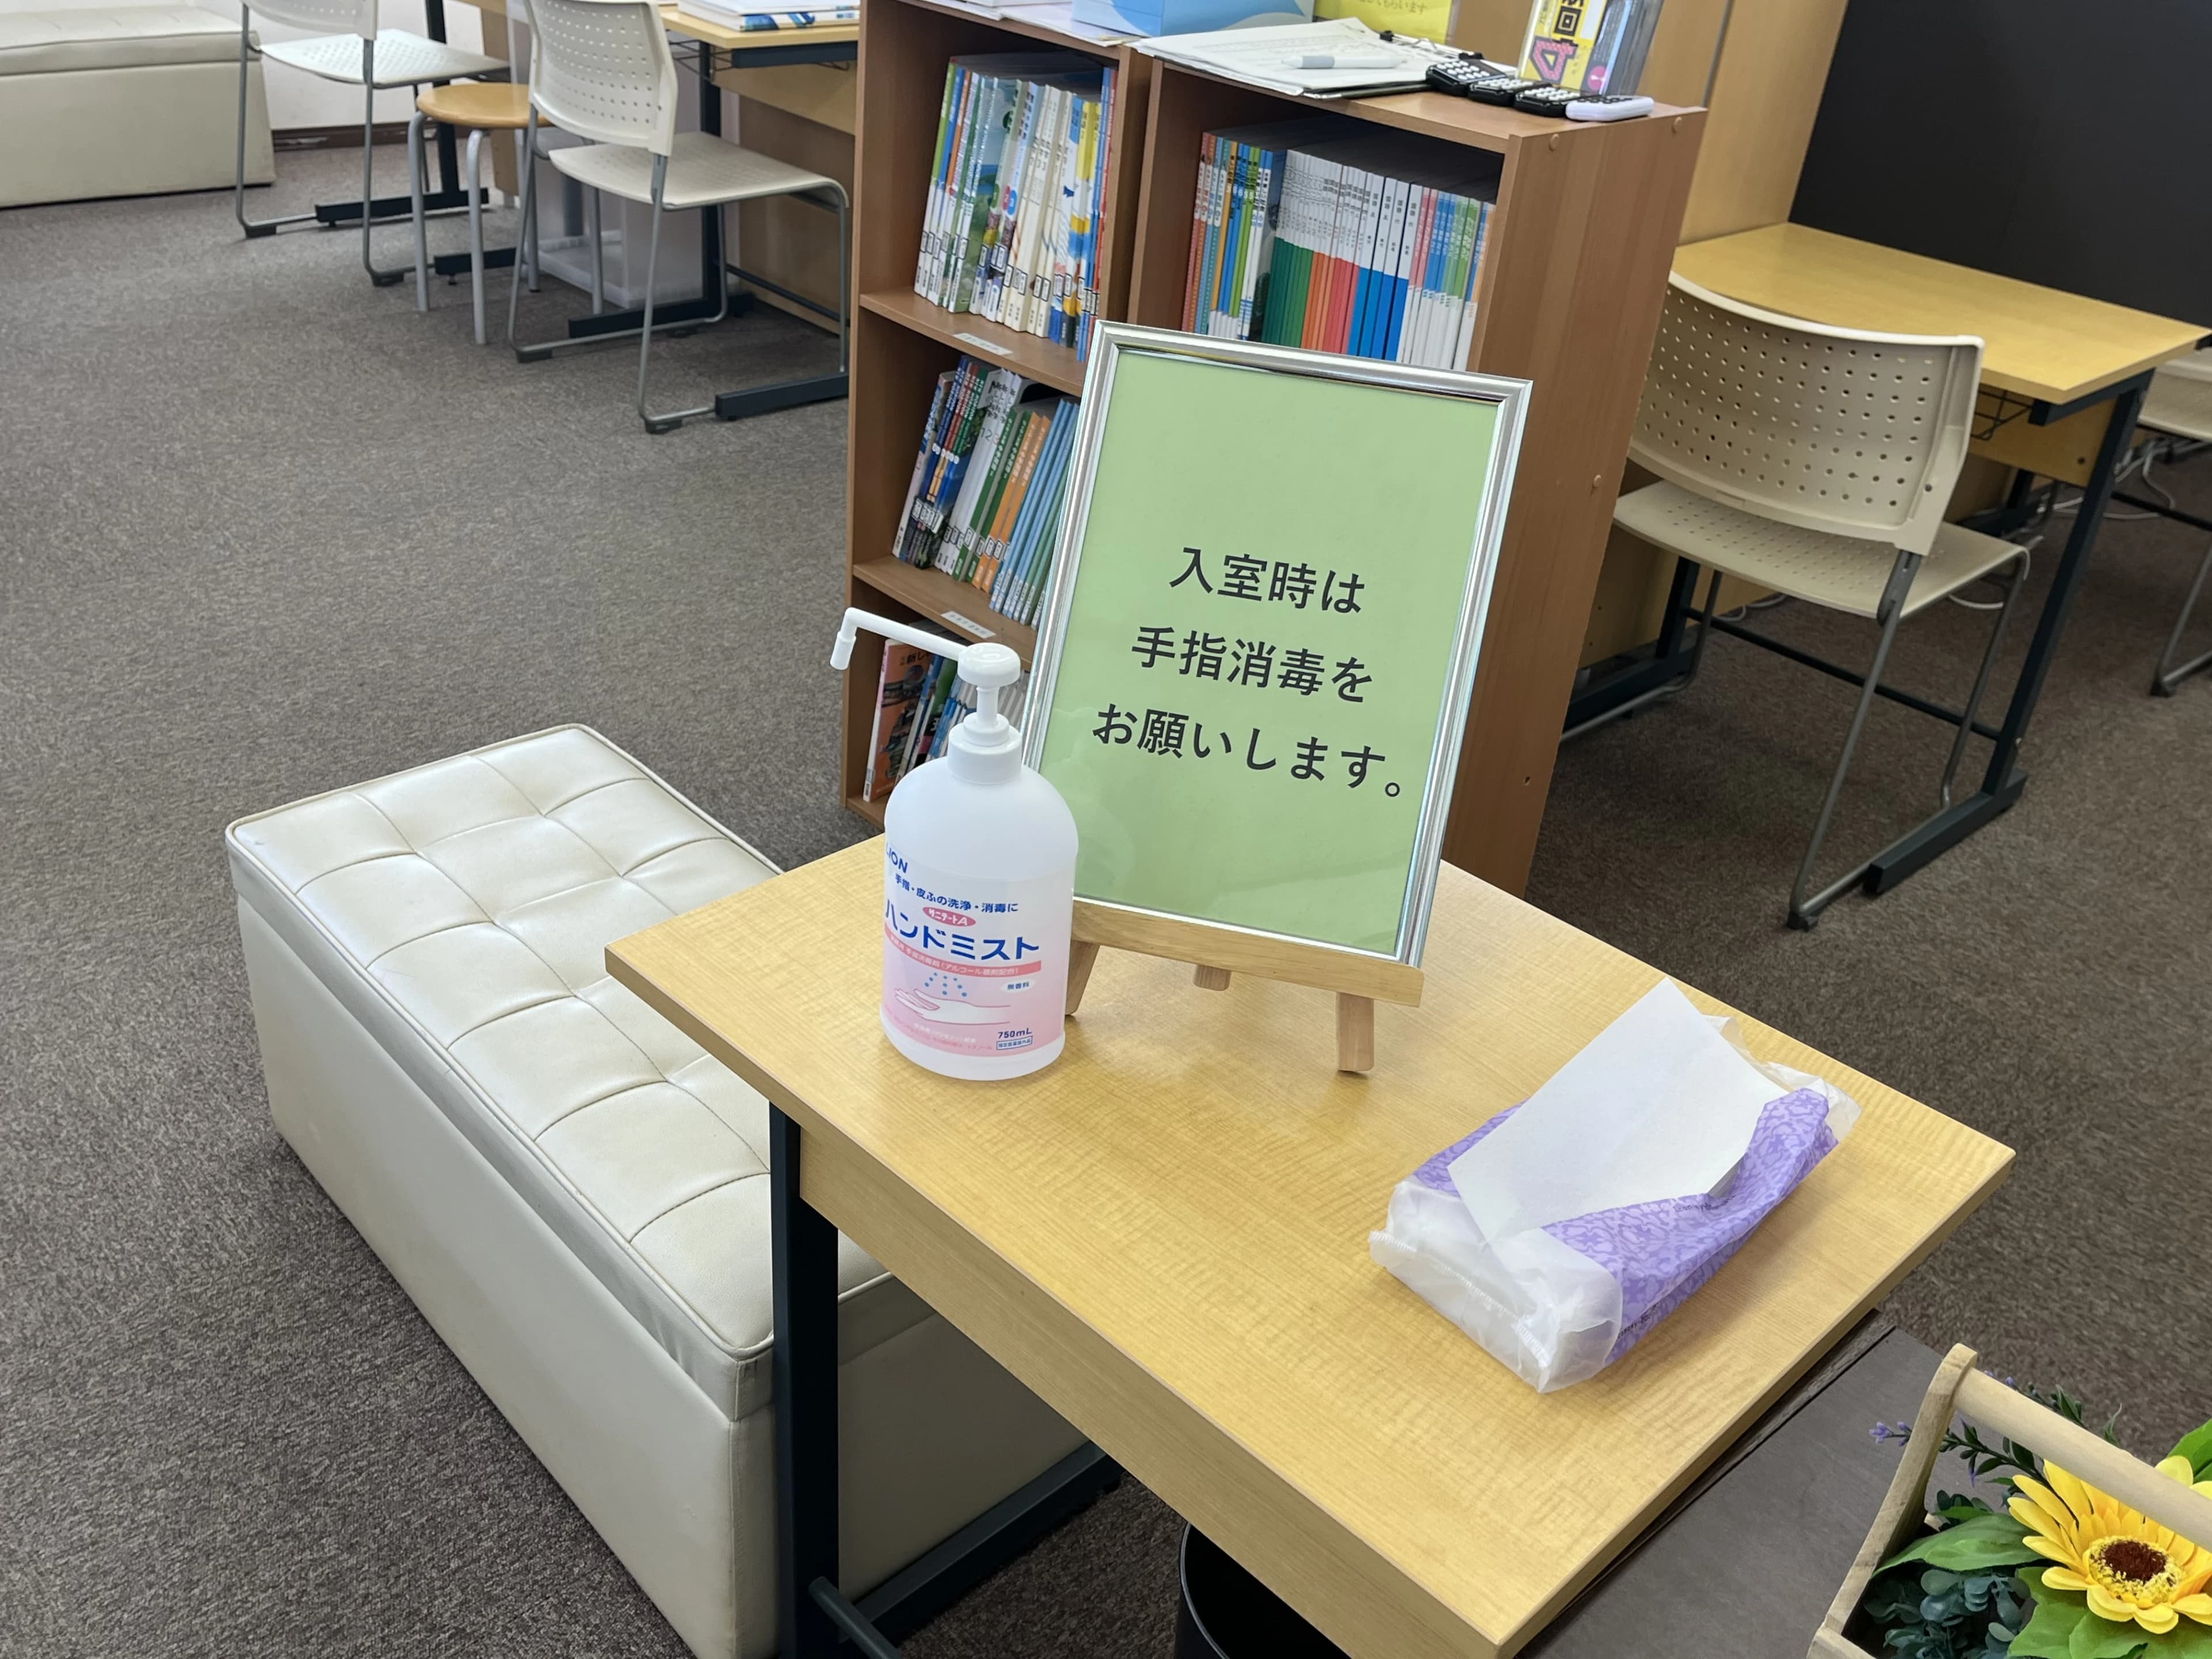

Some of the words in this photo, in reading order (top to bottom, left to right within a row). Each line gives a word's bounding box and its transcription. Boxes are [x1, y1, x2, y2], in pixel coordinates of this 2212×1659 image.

[1169, 547, 1365, 613] 入室時は
[1131, 627, 1372, 702] 手指消毒を
[1092, 703, 1400, 797] お願いします。
[886, 842, 908, 873] LION
[895, 873, 1018, 913] 手指・皮ふの洗浄・消毒に
[885, 899, 1039, 961] ハンドミスト
[998, 1028, 1032, 1039] 750mL
